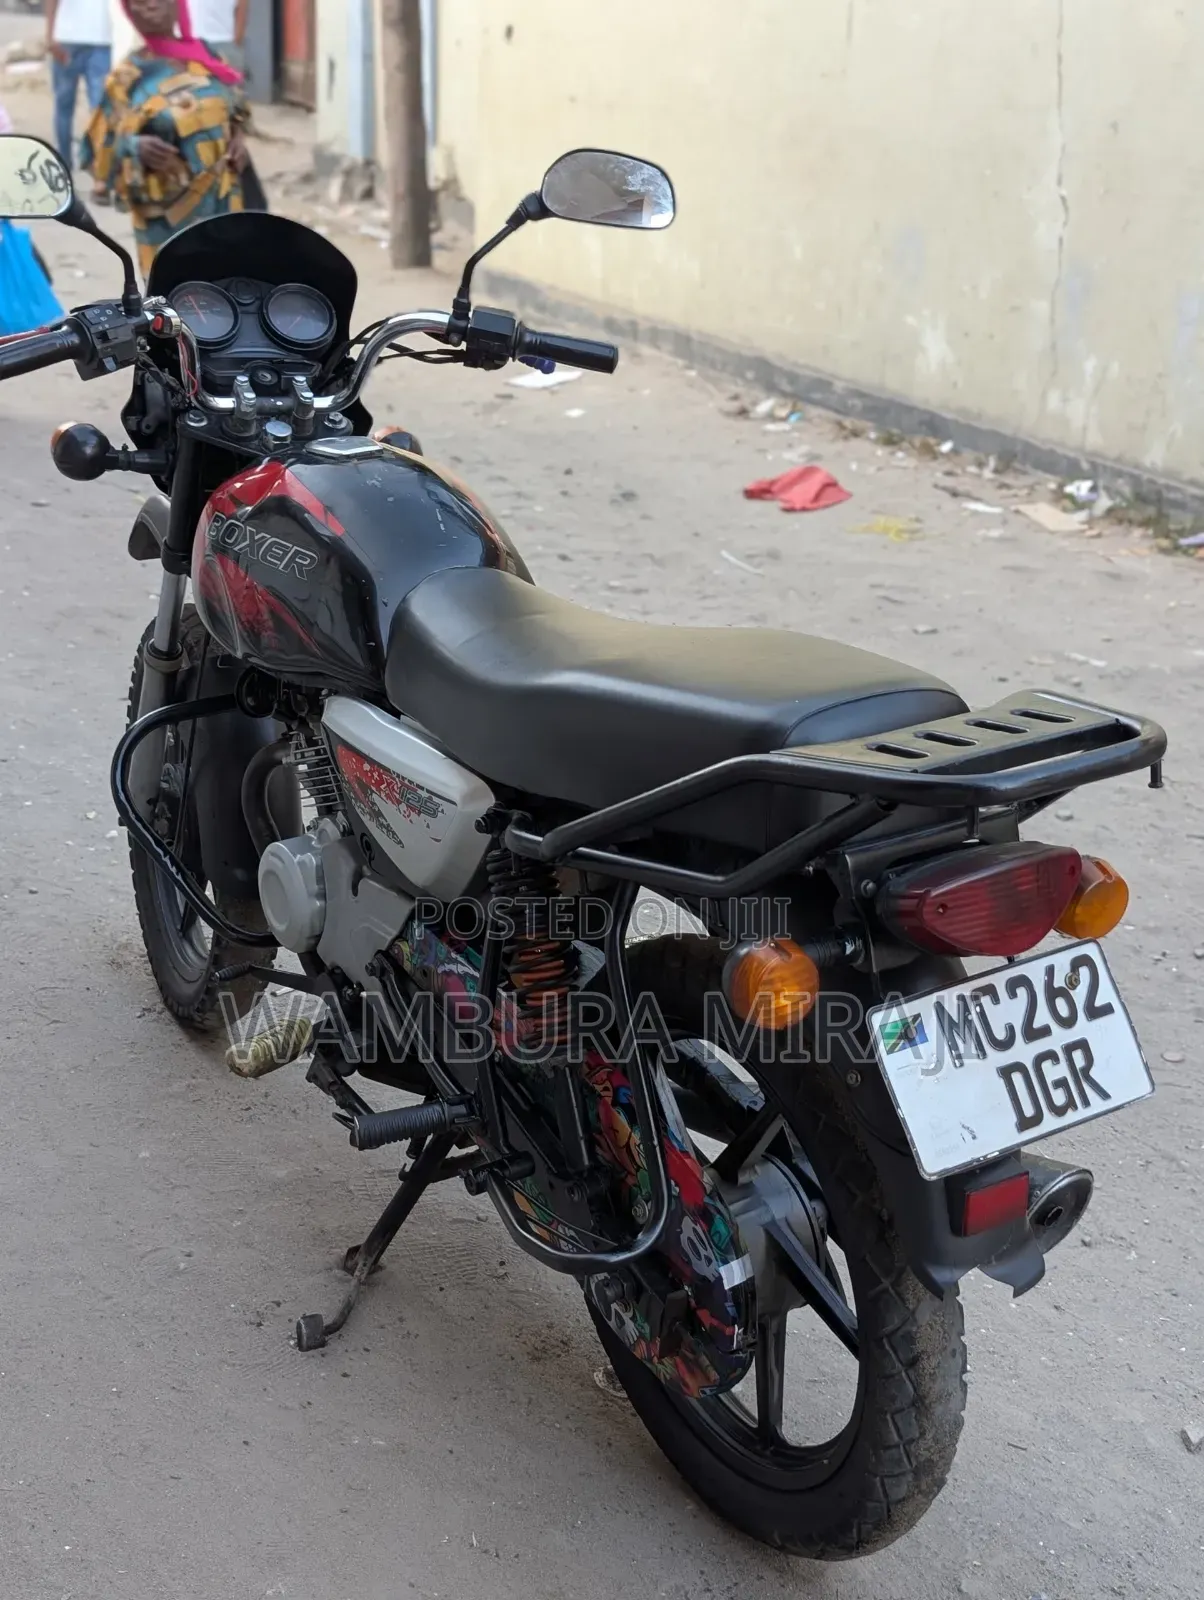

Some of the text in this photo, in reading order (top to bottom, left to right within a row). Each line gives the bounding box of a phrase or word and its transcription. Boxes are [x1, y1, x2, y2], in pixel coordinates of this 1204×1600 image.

[205, 511, 319, 581] BOXER
[933, 953, 1115, 1069] MC262
[996, 1036, 1112, 1134] DGR
